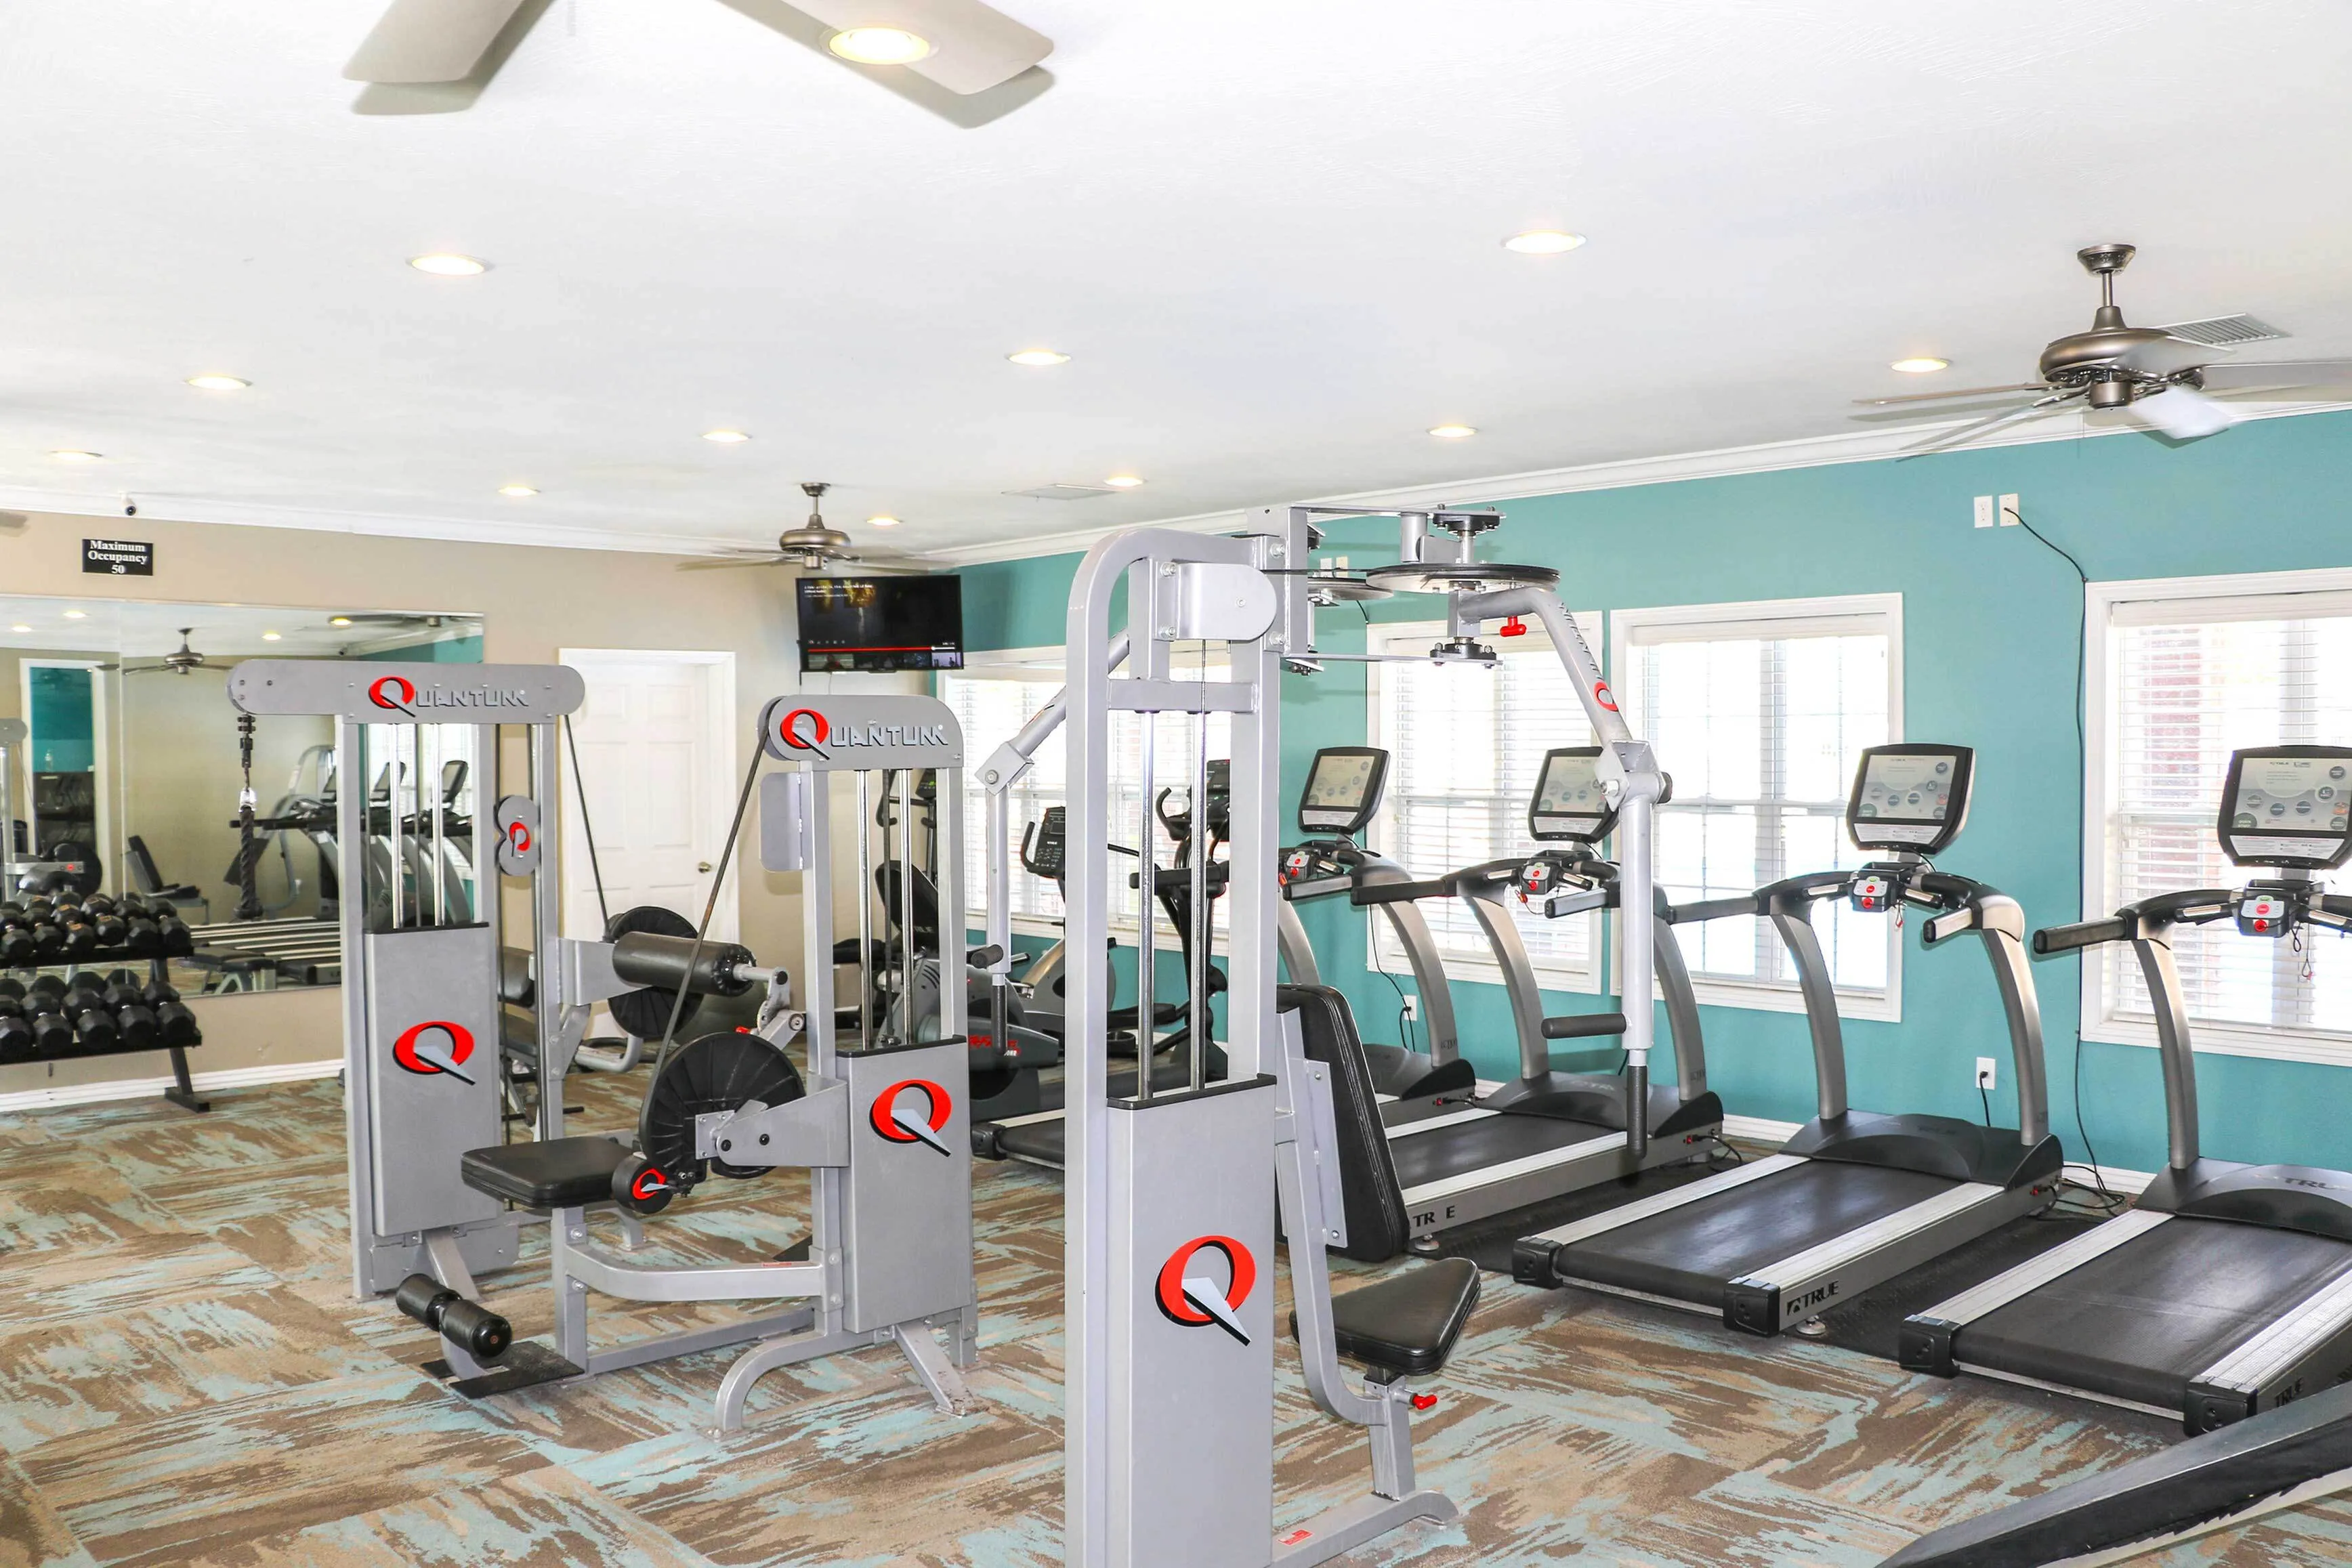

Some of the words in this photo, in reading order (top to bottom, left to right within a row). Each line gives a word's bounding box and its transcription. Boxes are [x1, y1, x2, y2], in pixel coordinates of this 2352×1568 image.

[87, 550, 147, 564] Occupancy
[90, 540, 146, 552] Maximum
[111, 564, 125, 574] 50
[369, 676, 529, 717] QUANTUM
[780, 708, 948, 760] QUANTUM
[1155, 1235, 1256, 1346] Q
[1801, 1280, 1839, 1308] TRUE
